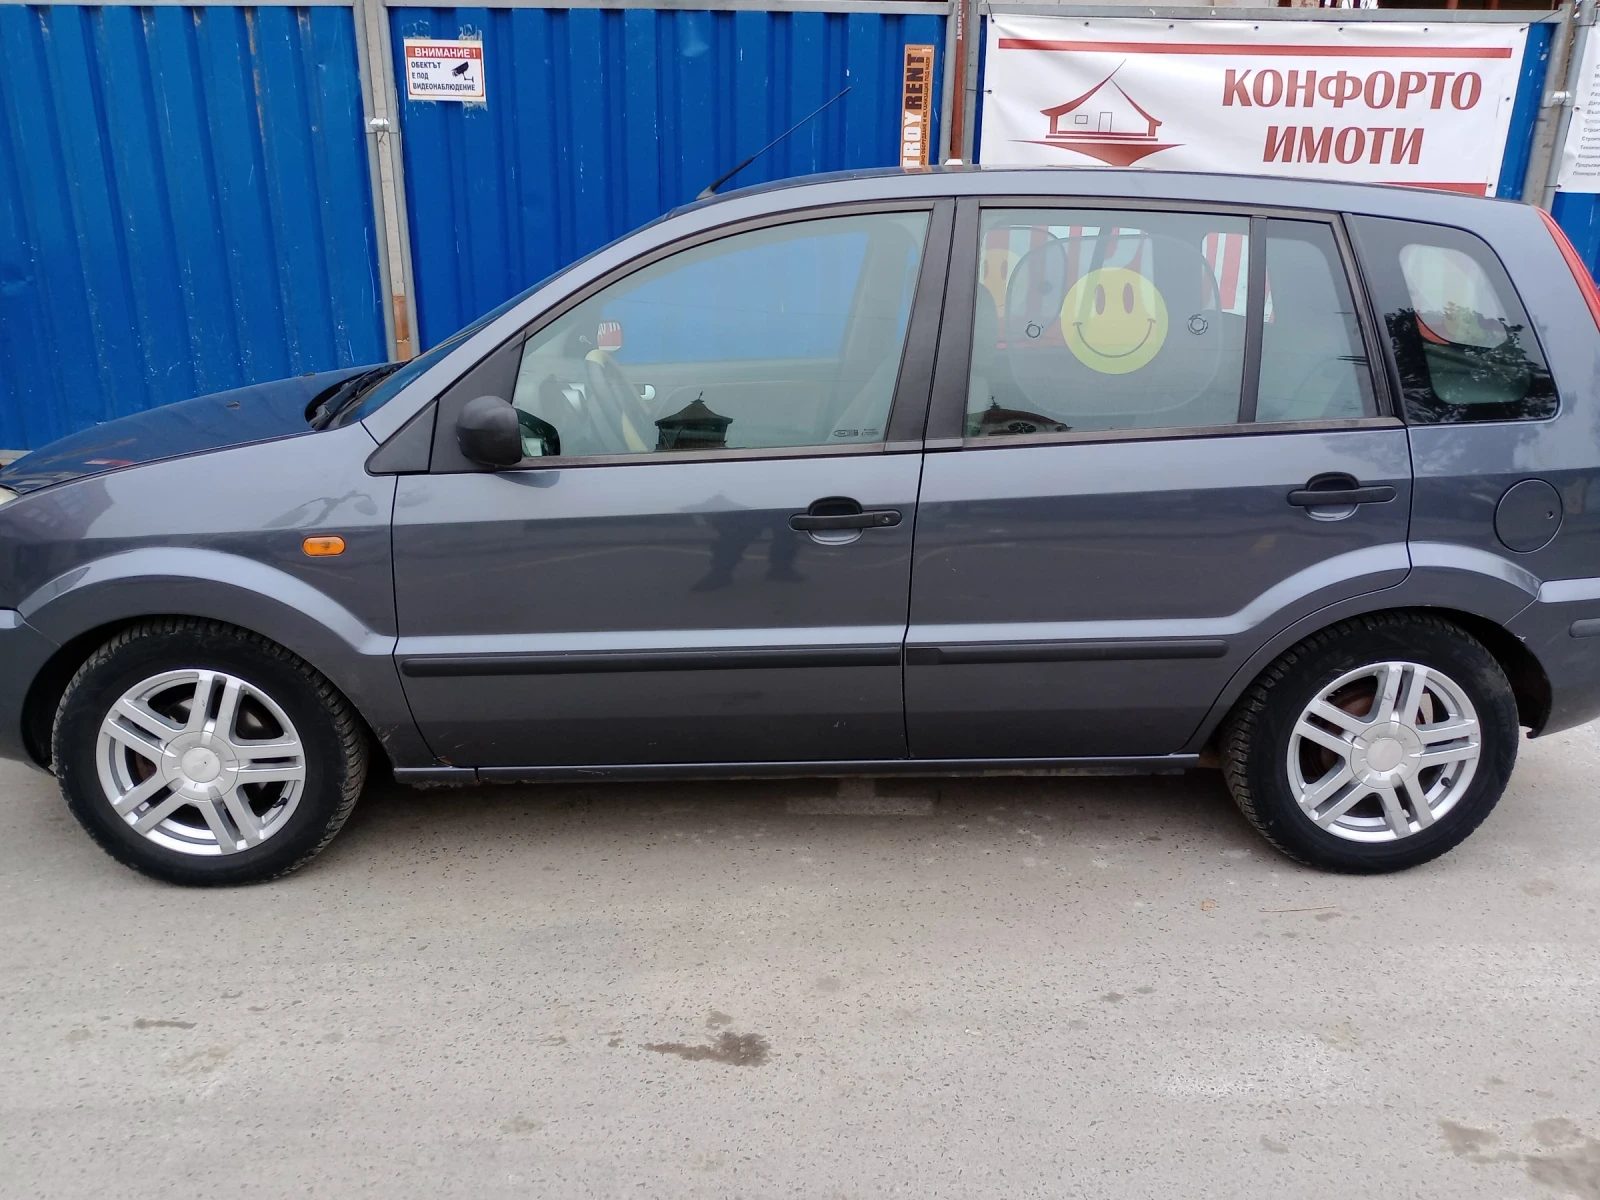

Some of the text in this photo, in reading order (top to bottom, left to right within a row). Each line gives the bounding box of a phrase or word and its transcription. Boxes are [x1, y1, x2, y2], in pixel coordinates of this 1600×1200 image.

[414, 47, 471, 58] ВНИМАНИЕ
[410, 61, 442, 69] ОБЕКТЪТ
[416, 72, 429, 81] ПОД
[412, 82, 476, 92] ВИДЕОНАБЛЮДЕНИЕ
[1222, 69, 1482, 110] КОНФОРТО
[1262, 126, 1425, 165] ИМОТИ
